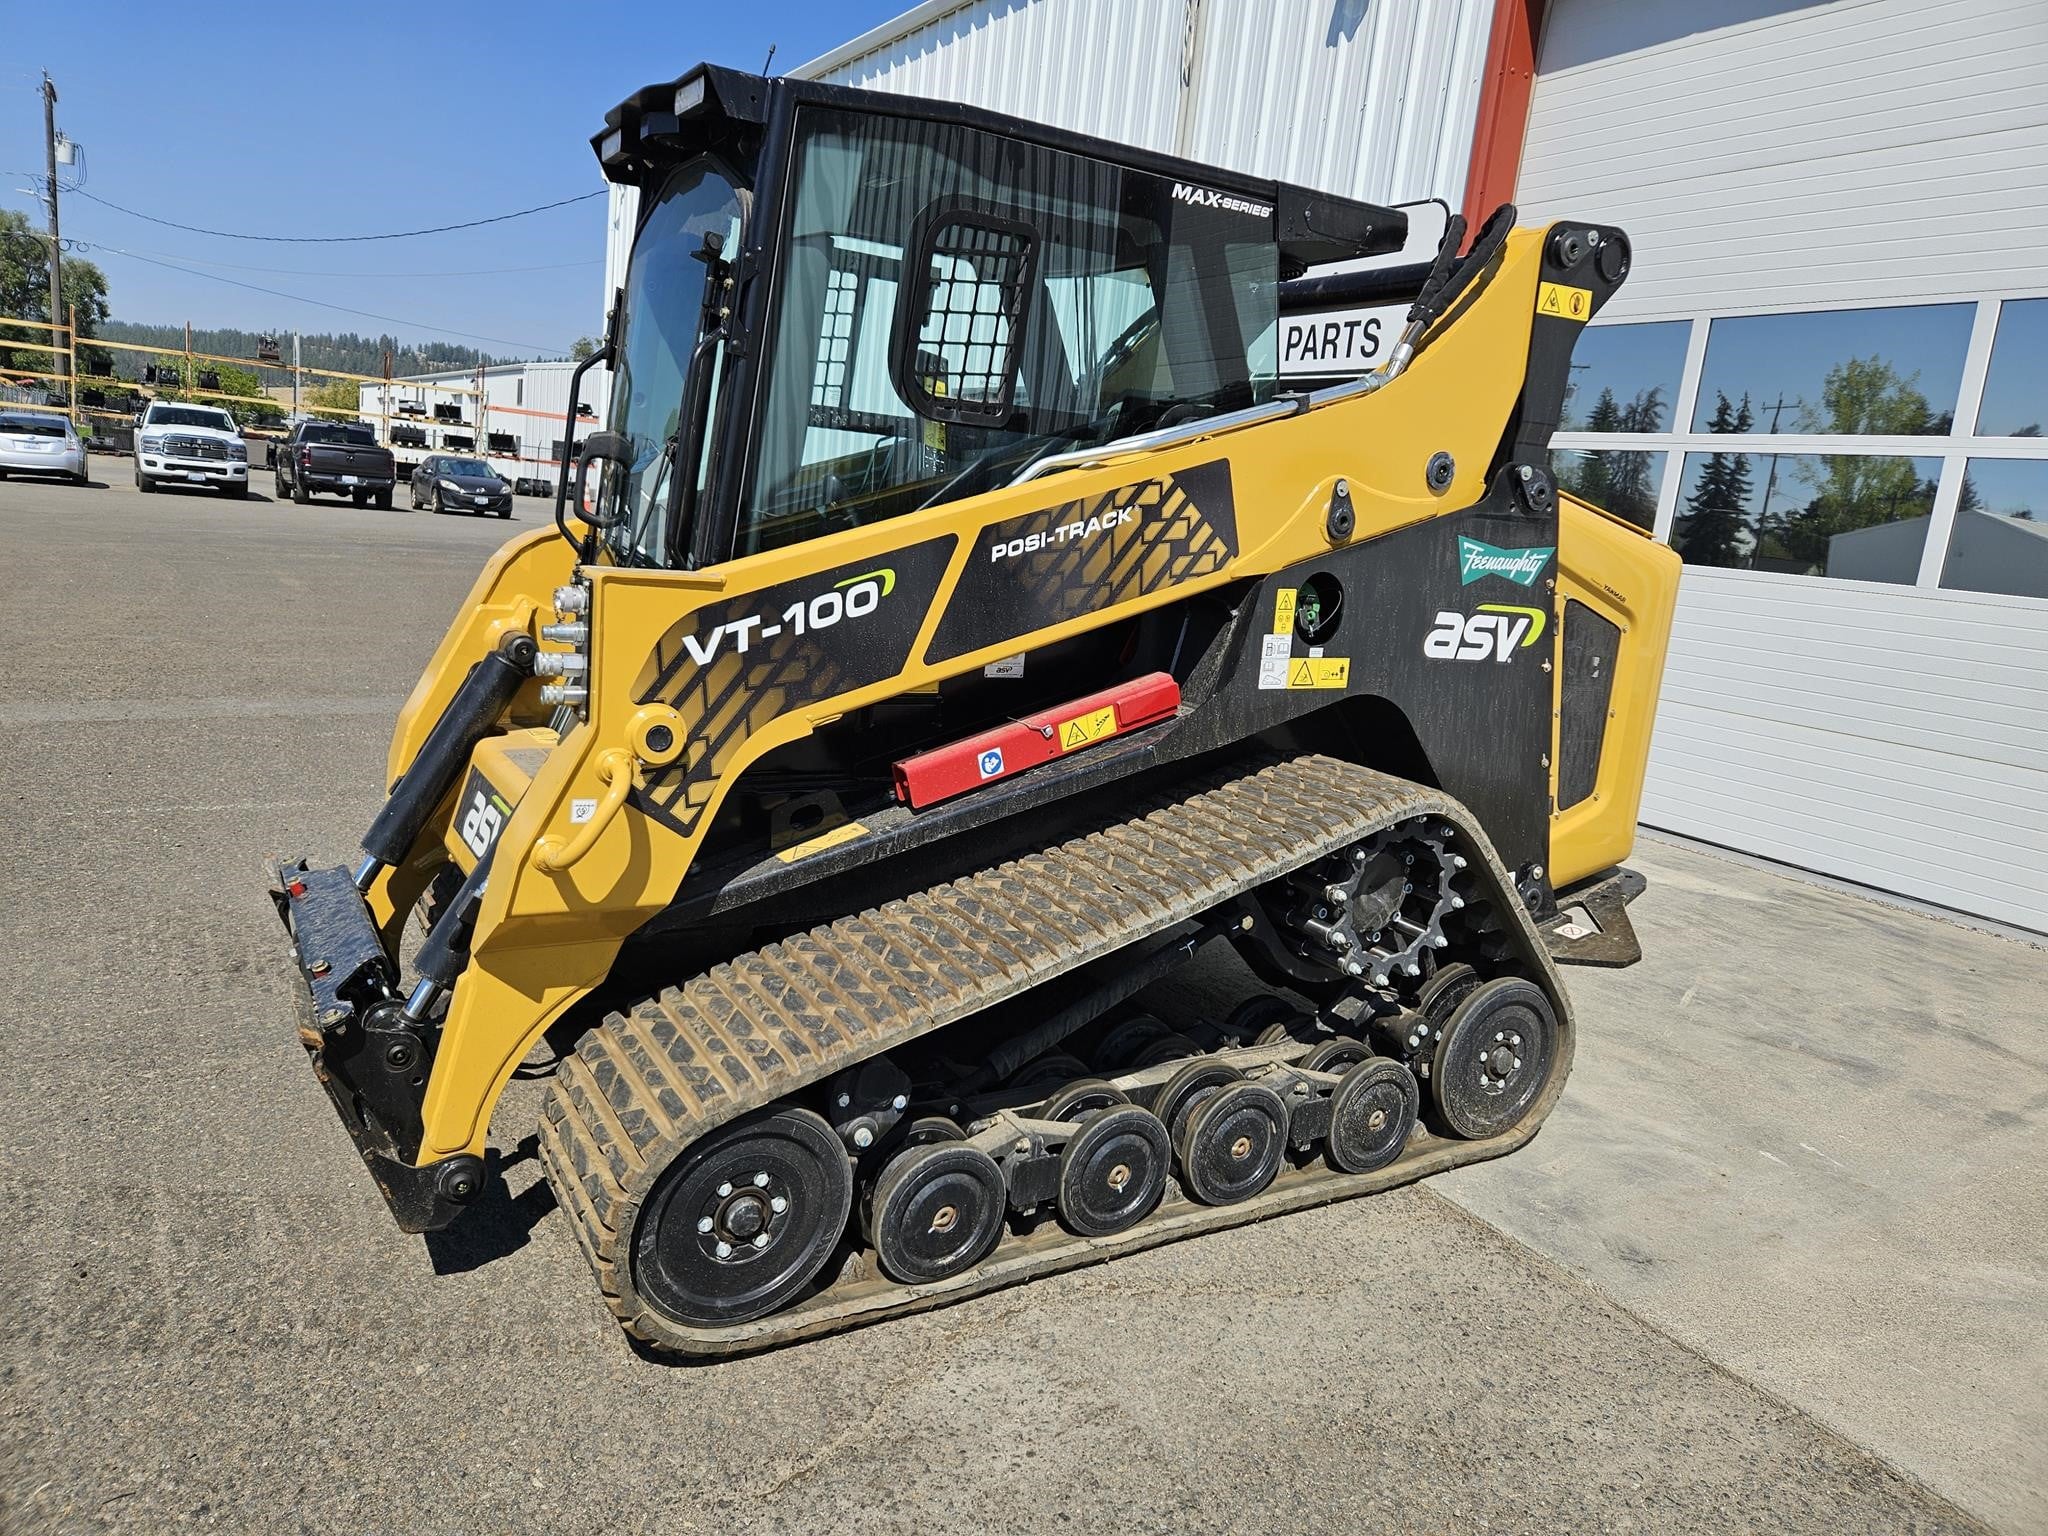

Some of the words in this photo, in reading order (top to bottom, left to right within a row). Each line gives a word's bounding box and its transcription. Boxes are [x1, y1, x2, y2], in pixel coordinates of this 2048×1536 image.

[1284, 317, 1381, 361] PARTS
[991, 506, 1133, 563] POSI-TRACK
[1463, 541, 1547, 585] Feenaughty
[681, 580, 879, 666] VT-100
[1423, 611, 1531, 663] asv
